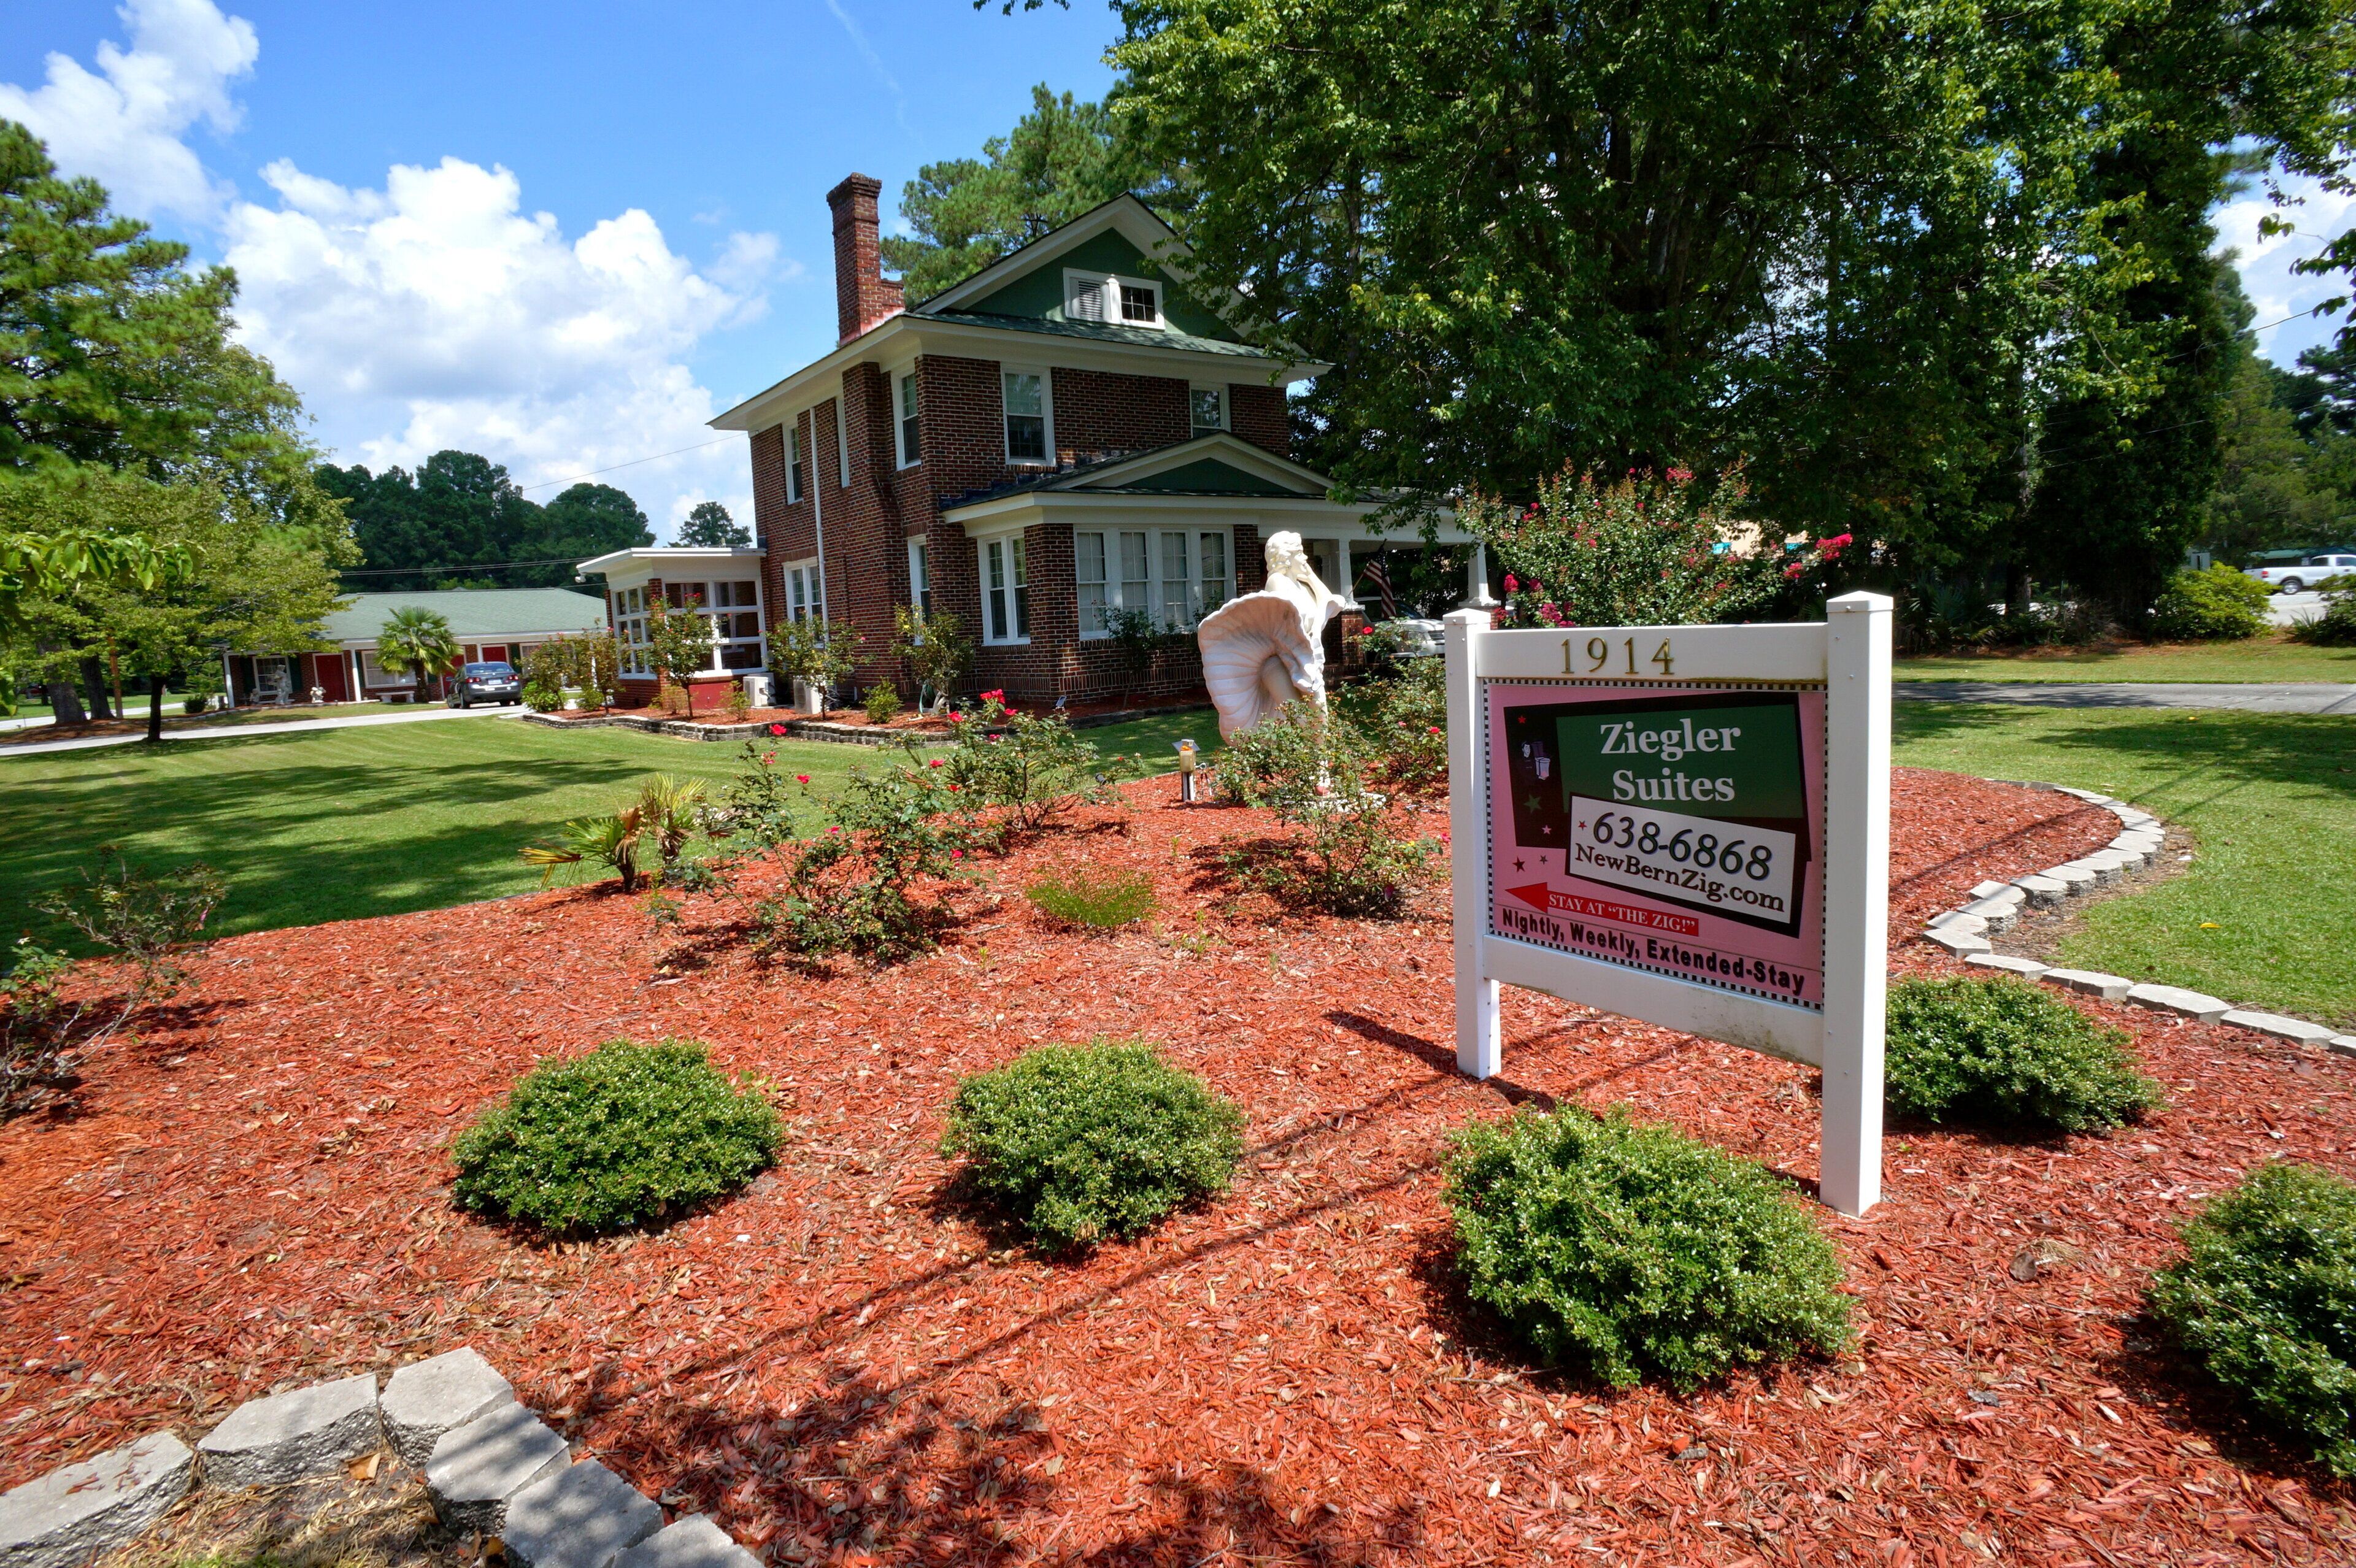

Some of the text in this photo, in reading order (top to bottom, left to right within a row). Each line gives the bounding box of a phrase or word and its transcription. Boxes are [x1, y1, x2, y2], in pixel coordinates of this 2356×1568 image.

[1560, 636, 1674, 675] 1914
[1600, 718, 1741, 762] Ziegler
[1613, 768, 1736, 802] Suites
[1593, 812, 1773, 880] 638-6868
[1575, 843, 1785, 912] NewBernZig.com
[1549, 894, 1584, 911] STAY
[1586, 903, 1605, 915] AT
[1503, 908, 1805, 996] Nightly, Weekly, Extended-Stay
